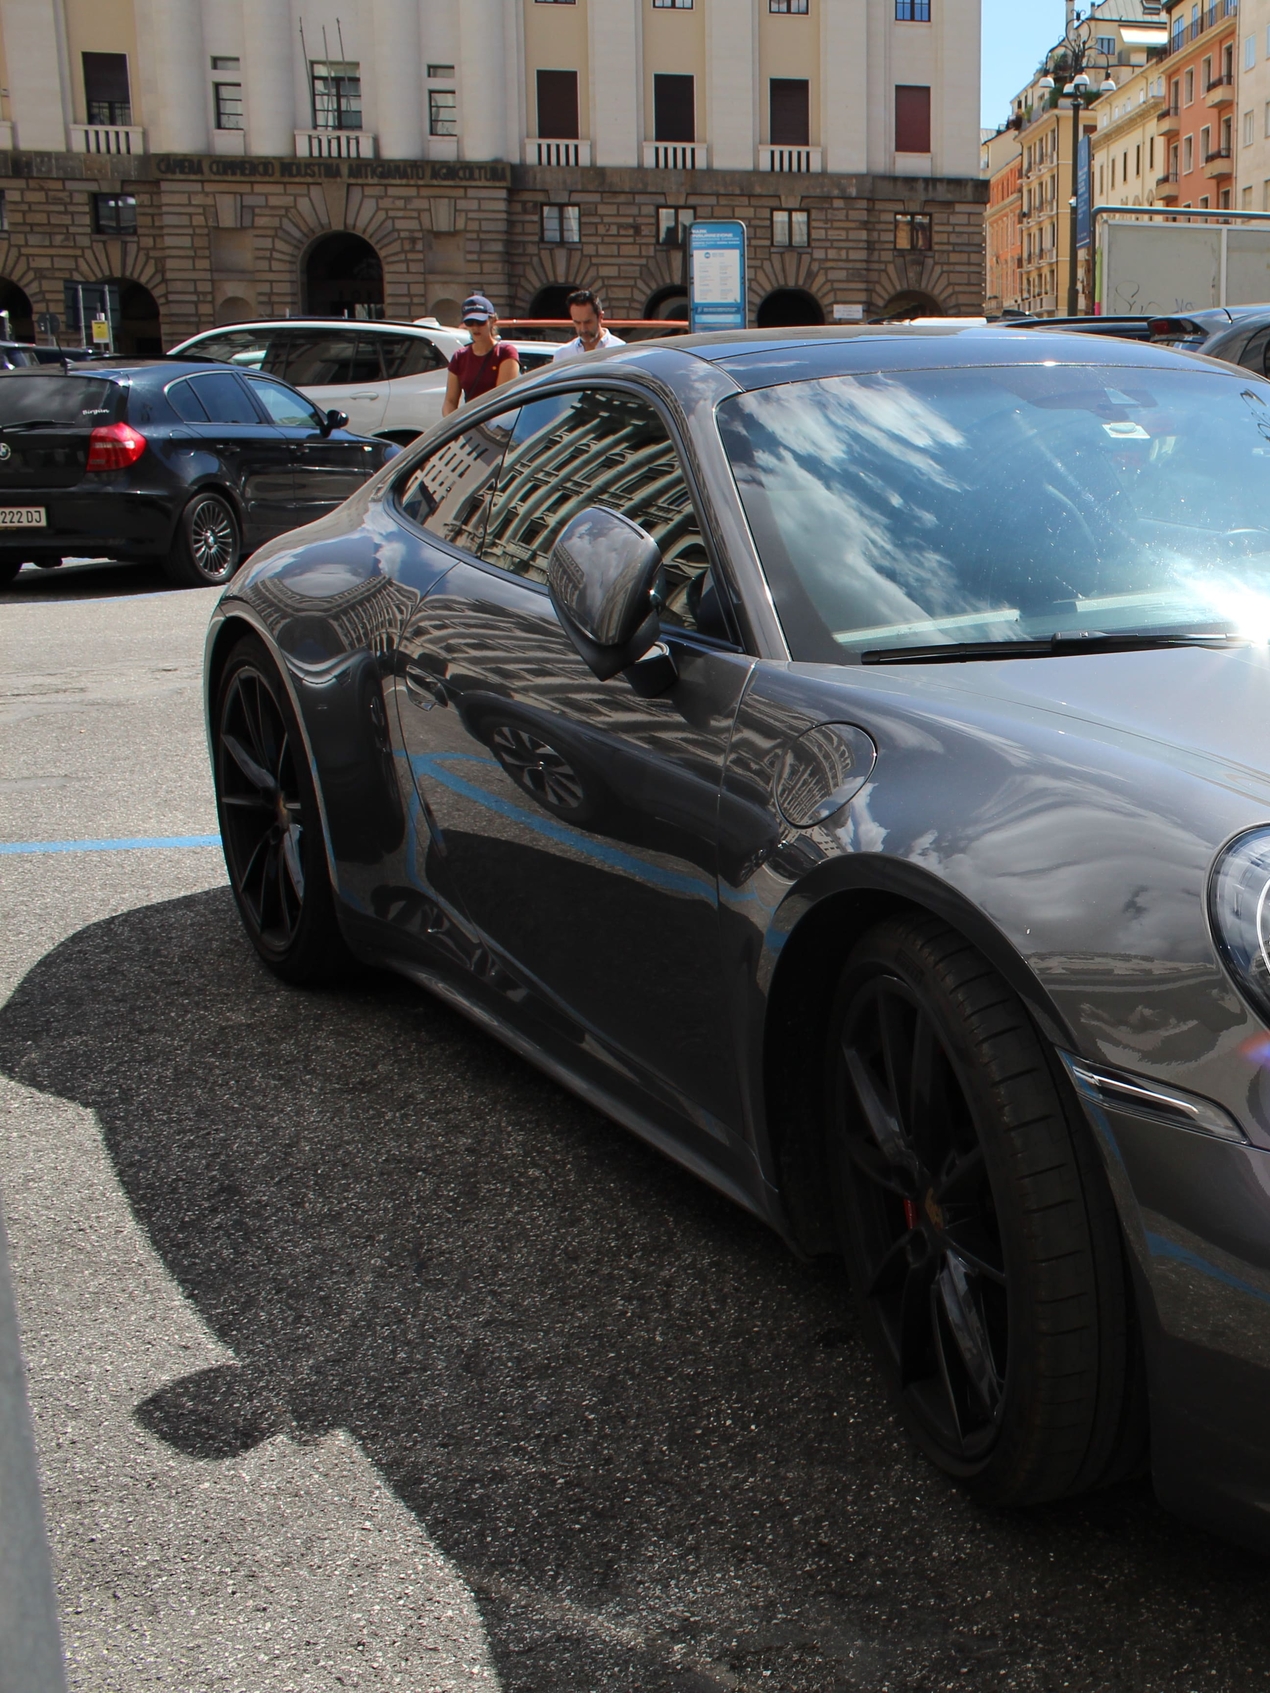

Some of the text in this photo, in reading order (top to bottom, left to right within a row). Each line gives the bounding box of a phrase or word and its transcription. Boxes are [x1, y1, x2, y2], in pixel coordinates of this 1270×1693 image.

[156, 157, 508, 182] CAMERA COMMERCIO INDUSTRIA ARTIGIANATO AGRICOLTURA
[26, 510, 42, 523] DJ
